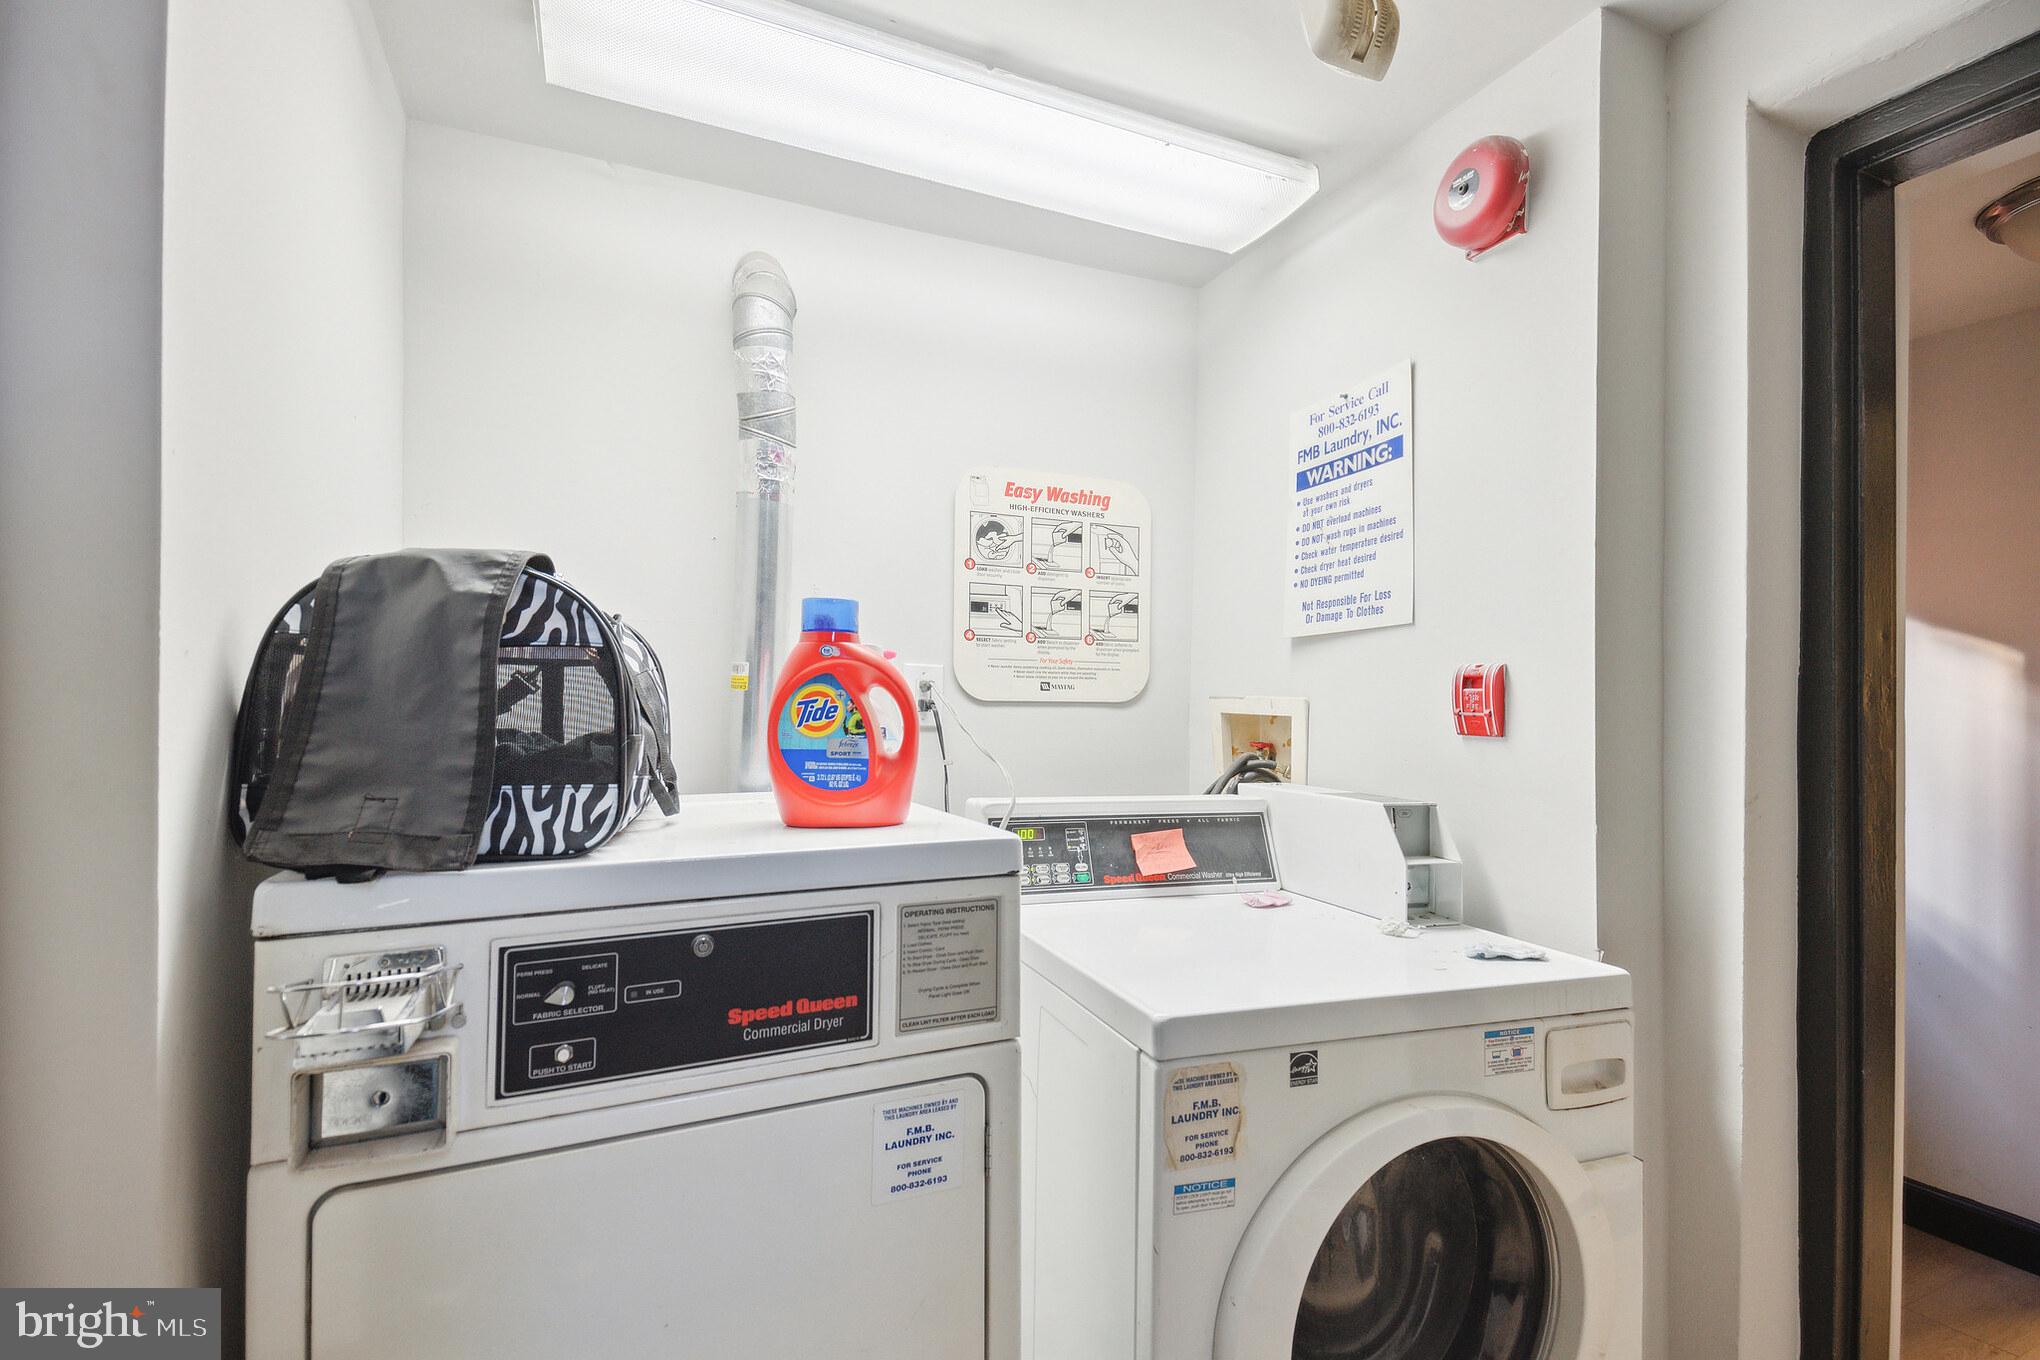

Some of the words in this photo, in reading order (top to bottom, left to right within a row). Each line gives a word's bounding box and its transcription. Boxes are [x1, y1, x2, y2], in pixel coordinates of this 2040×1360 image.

[1310, 412, 1325, 426] For
[1328, 397, 1364, 418] Service
[1368, 381, 1389, 400] Call
[1318, 403, 1380, 438] 800-832-6193
[1298, 444, 1320, 464] FMB
[1324, 430, 1372, 455] Laundry,
[1376, 412, 1402, 436] INC.
[1306, 443, 1393, 486] WARNING:
[1004, 482, 1043, 504] Easy
[1046, 486, 1112, 512] Washing
[1303, 496, 1313, 506] Use
[1316, 489, 1338, 502] washers
[1341, 484, 1352, 496] and
[1354, 478, 1374, 492] dryers
[1010, 504, 1070, 516] HIGH-EFFICIENCY
[1071, 510, 1105, 518] WASHERS
[1302, 508, 1309, 518] at
[1311, 506, 1324, 517] your
[1326, 502, 1338, 512] own
[1339, 496, 1350, 508] risk
[1302, 523, 1310, 532] DO
[1326, 512, 1352, 526] overload
[1353, 504, 1382, 520] machines
[1301, 536, 1310, 546] DO
[1312, 534, 1324, 544] NOT
[1326, 530, 1340, 542] wash
[1342, 526, 1356, 538] rugs
[1358, 522, 1365, 533] in
[1366, 516, 1397, 531] machines
[1300, 549, 1318, 561] Check
[1320, 546, 1338, 557] water
[1339, 536, 1378, 553] temperature
[1380, 528, 1404, 544] desired
[1300, 563, 1318, 575] Check
[1320, 560, 1336, 572] dryer
[1338, 556, 1352, 568] heat
[1354, 550, 1378, 566] desired
[1300, 579, 1308, 589] NO
[1310, 574, 1332, 587] DYEING
[1334, 568, 1365, 584] permitted
[1302, 600, 1314, 612] Not
[1316, 594, 1357, 611] Responsible
[1360, 592, 1372, 604] For
[1374, 590, 1392, 600] Loss
[1306, 614, 1313, 624] Or
[1316, 610, 1343, 623] Damage
[1346, 608, 1354, 619] To
[1356, 604, 1384, 618] Clothes
[796, 698, 840, 729] Tide
[1104, 874, 1134, 884] Speed
[1167, 872, 1200, 881] Commercial
[904, 908, 944, 918] OPERATING
[946, 904, 995, 914] INSTRUCTIONS
[582, 962, 608, 970] DELICATE
[532, 1010, 562, 1020] FABRIC
[563, 1005, 604, 1016] SELECTOR
[728, 1000, 793, 1026] Speed
[796, 995, 858, 1014] Queen
[744, 1021, 811, 1041] Commercial
[814, 1016, 844, 1032] Dryer
[532, 1067, 556, 1076] PUSH
[556, 1065, 567, 1073] TO
[568, 1062, 592, 1072] START
[898, 1104, 922, 1112] MACHINES
[924, 1100, 940, 1108] OWNED
[1193, 1099, 1221, 1110] F.M.B.
[896, 1111, 918, 1120] LAUNDRY
[1171, 1110, 1219, 1124] LAUNDRY
[1222, 1106, 1241, 1116] INC.
[906, 1124, 934, 1136] F.M.B.
[1200, 1129, 1228, 1140] SERVICE
[885, 1134, 932, 1151] LAUNDRY
[935, 1131, 955, 1142] INC.
[1196, 1140, 1218, 1150] PHONE
[912, 1156, 943, 1168] SERVICE
[1180, 1146, 1234, 1163] 800-832-6193
[908, 1168, 932, 1178] PHONE
[890, 1175, 948, 1194] 800-832-6193
[1183, 1180, 1228, 1192] NOTICE
